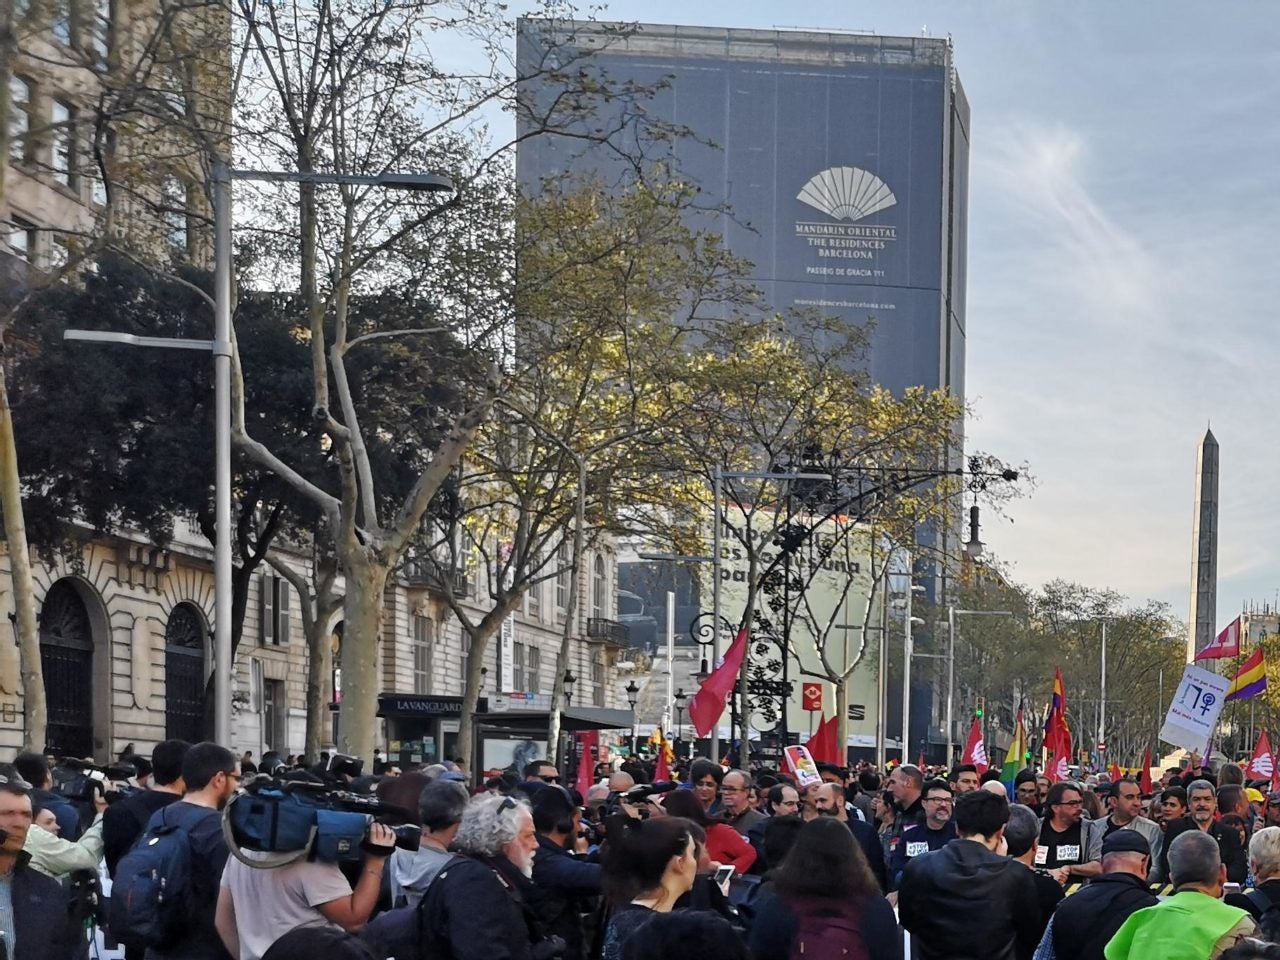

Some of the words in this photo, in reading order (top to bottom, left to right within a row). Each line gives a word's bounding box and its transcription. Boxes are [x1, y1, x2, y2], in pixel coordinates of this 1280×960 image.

[796, 225, 845, 235] MANDARIN
[848, 227, 896, 238] ORIENTAL
[808, 238, 827, 246] THE
[829, 239, 885, 249] RESIDENCES
[819, 249, 873, 259] BARCELONA
[806, 267, 834, 275] PASSEIG
[836, 268, 845, 276] DE
